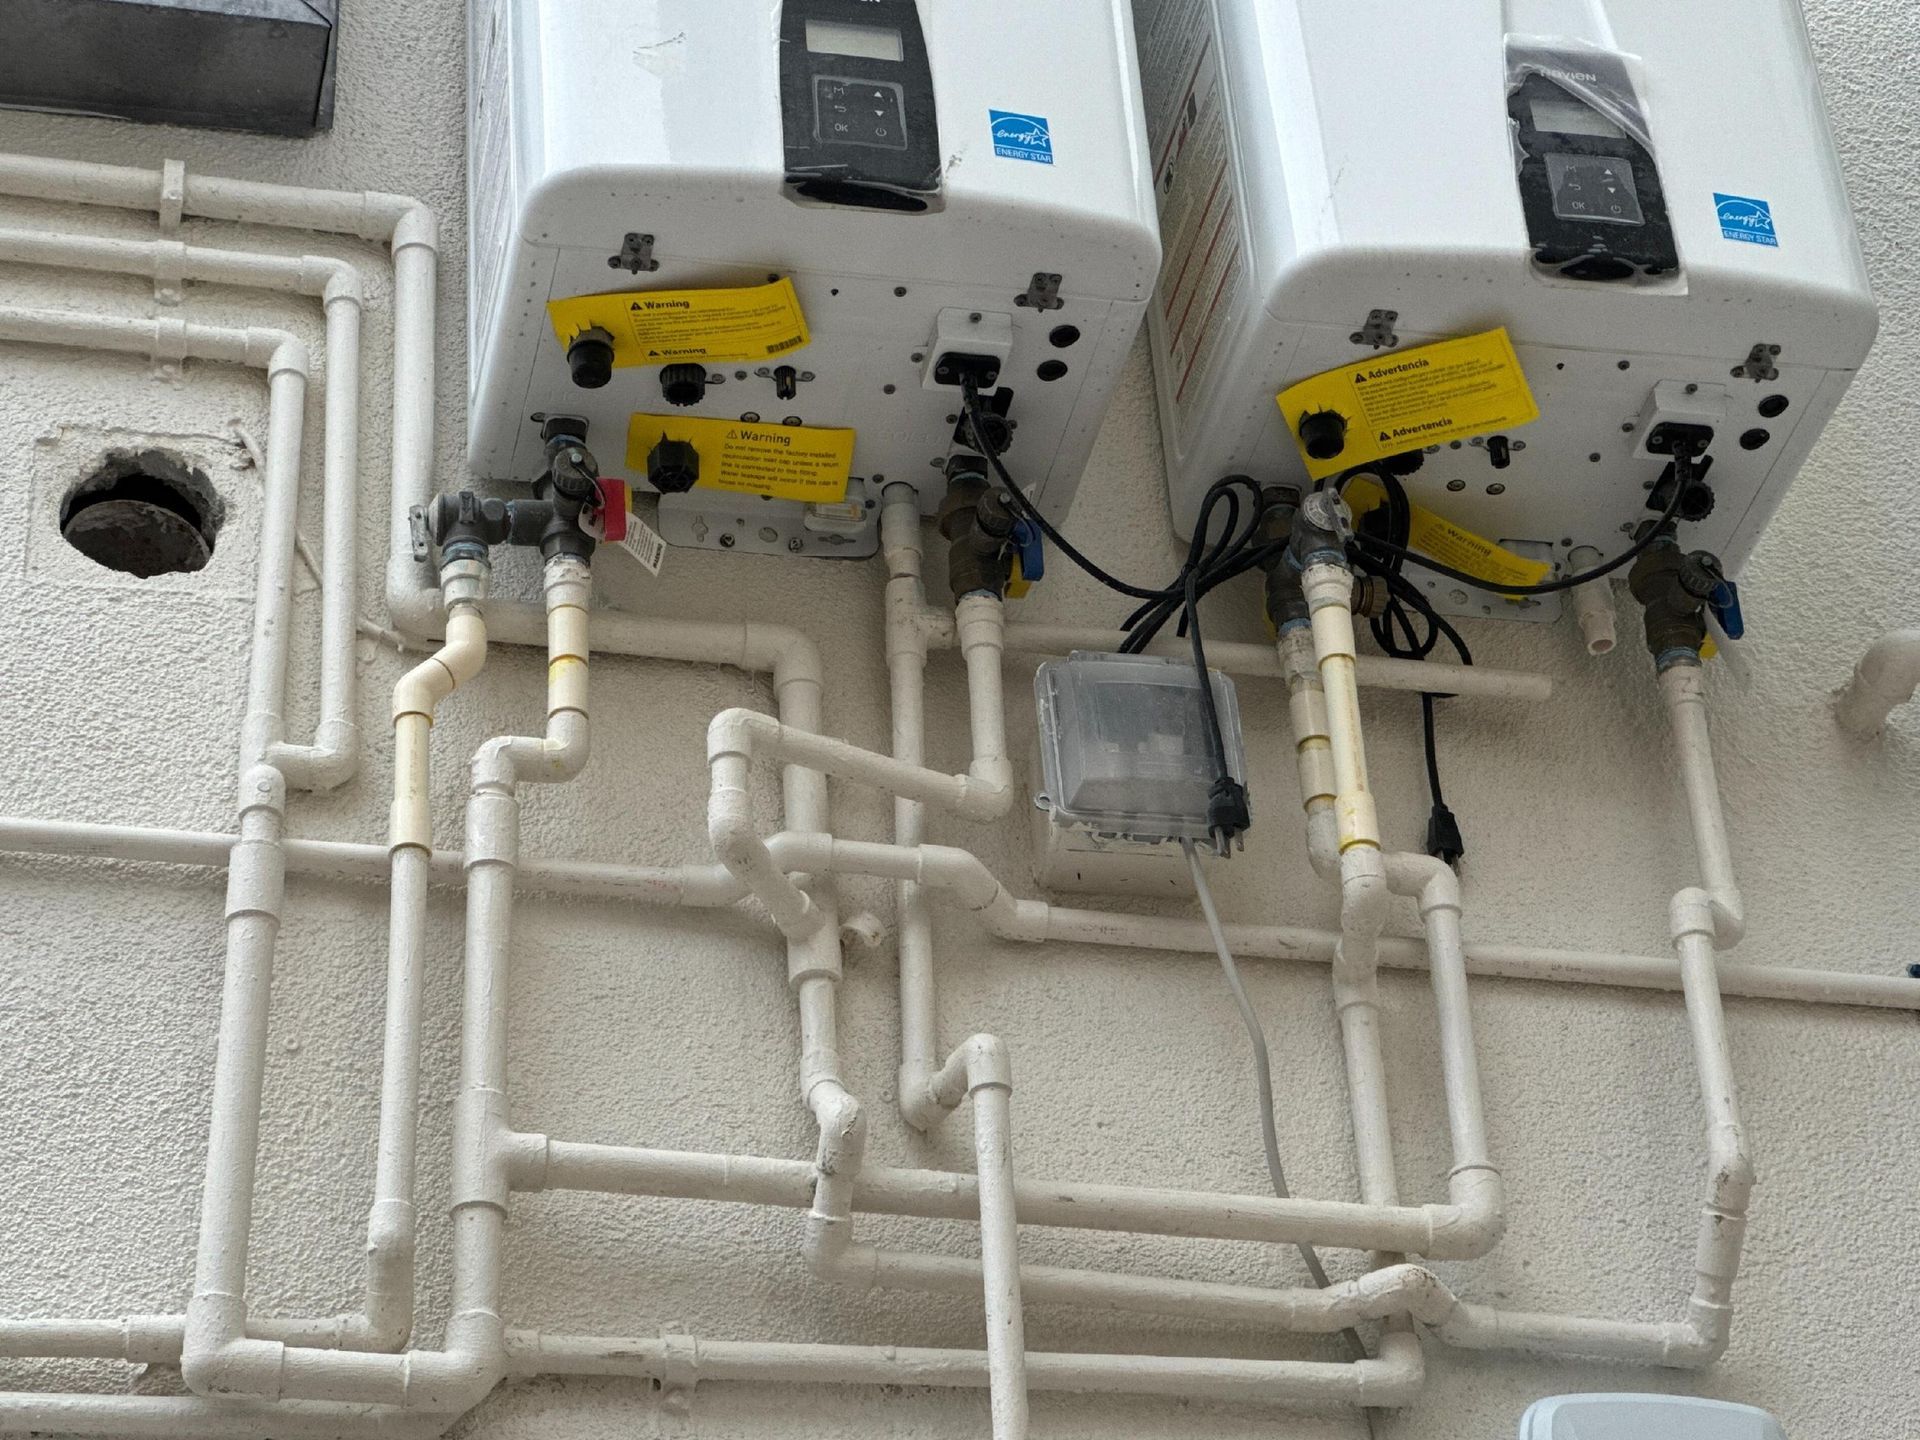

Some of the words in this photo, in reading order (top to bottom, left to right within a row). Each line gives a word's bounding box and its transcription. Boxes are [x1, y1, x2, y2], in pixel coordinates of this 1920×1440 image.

[834, 123, 848, 132] OK
[996, 148, 1029, 158] ENERGY
[1030, 153, 1052, 162] STAR
[1572, 201, 1585, 210] OK
[1724, 231, 1755, 241] ENERGY
[1756, 235, 1777, 245] STAR
[644, 300, 690, 310] Warning
[662, 347, 706, 357] Warning
[1368, 358, 1429, 379] Advertencia
[1392, 416, 1453, 438] Advertencia
[741, 430, 791, 446] Warning
[1448, 528, 1492, 556] Warning
